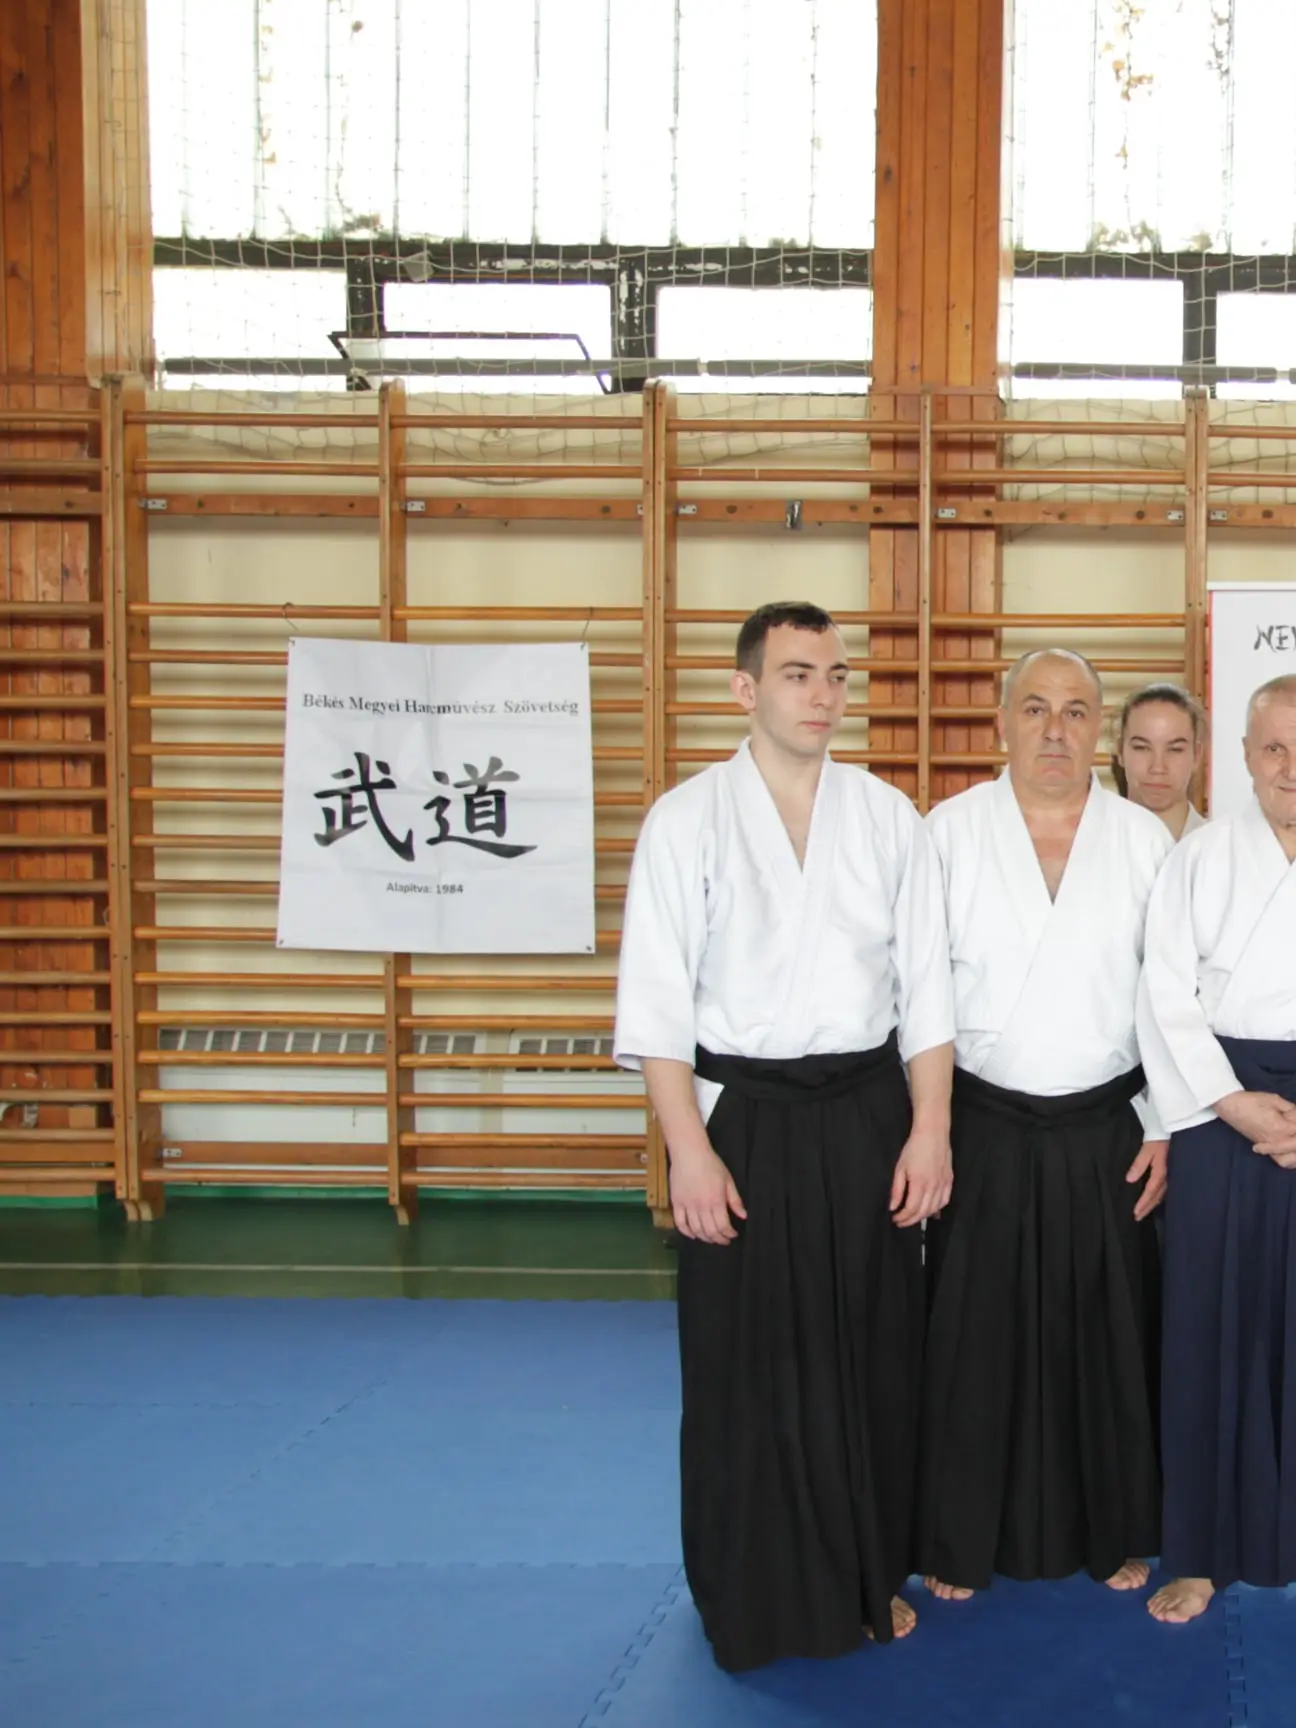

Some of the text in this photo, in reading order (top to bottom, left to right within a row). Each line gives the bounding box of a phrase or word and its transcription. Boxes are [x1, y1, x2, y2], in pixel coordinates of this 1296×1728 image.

[303, 693, 344, 709] Békés
[349, 696, 400, 714] Megyei
[503, 699, 579, 716] Szövetség
[313, 751, 538, 862] 武道
[436, 883, 464, 895] 1984
